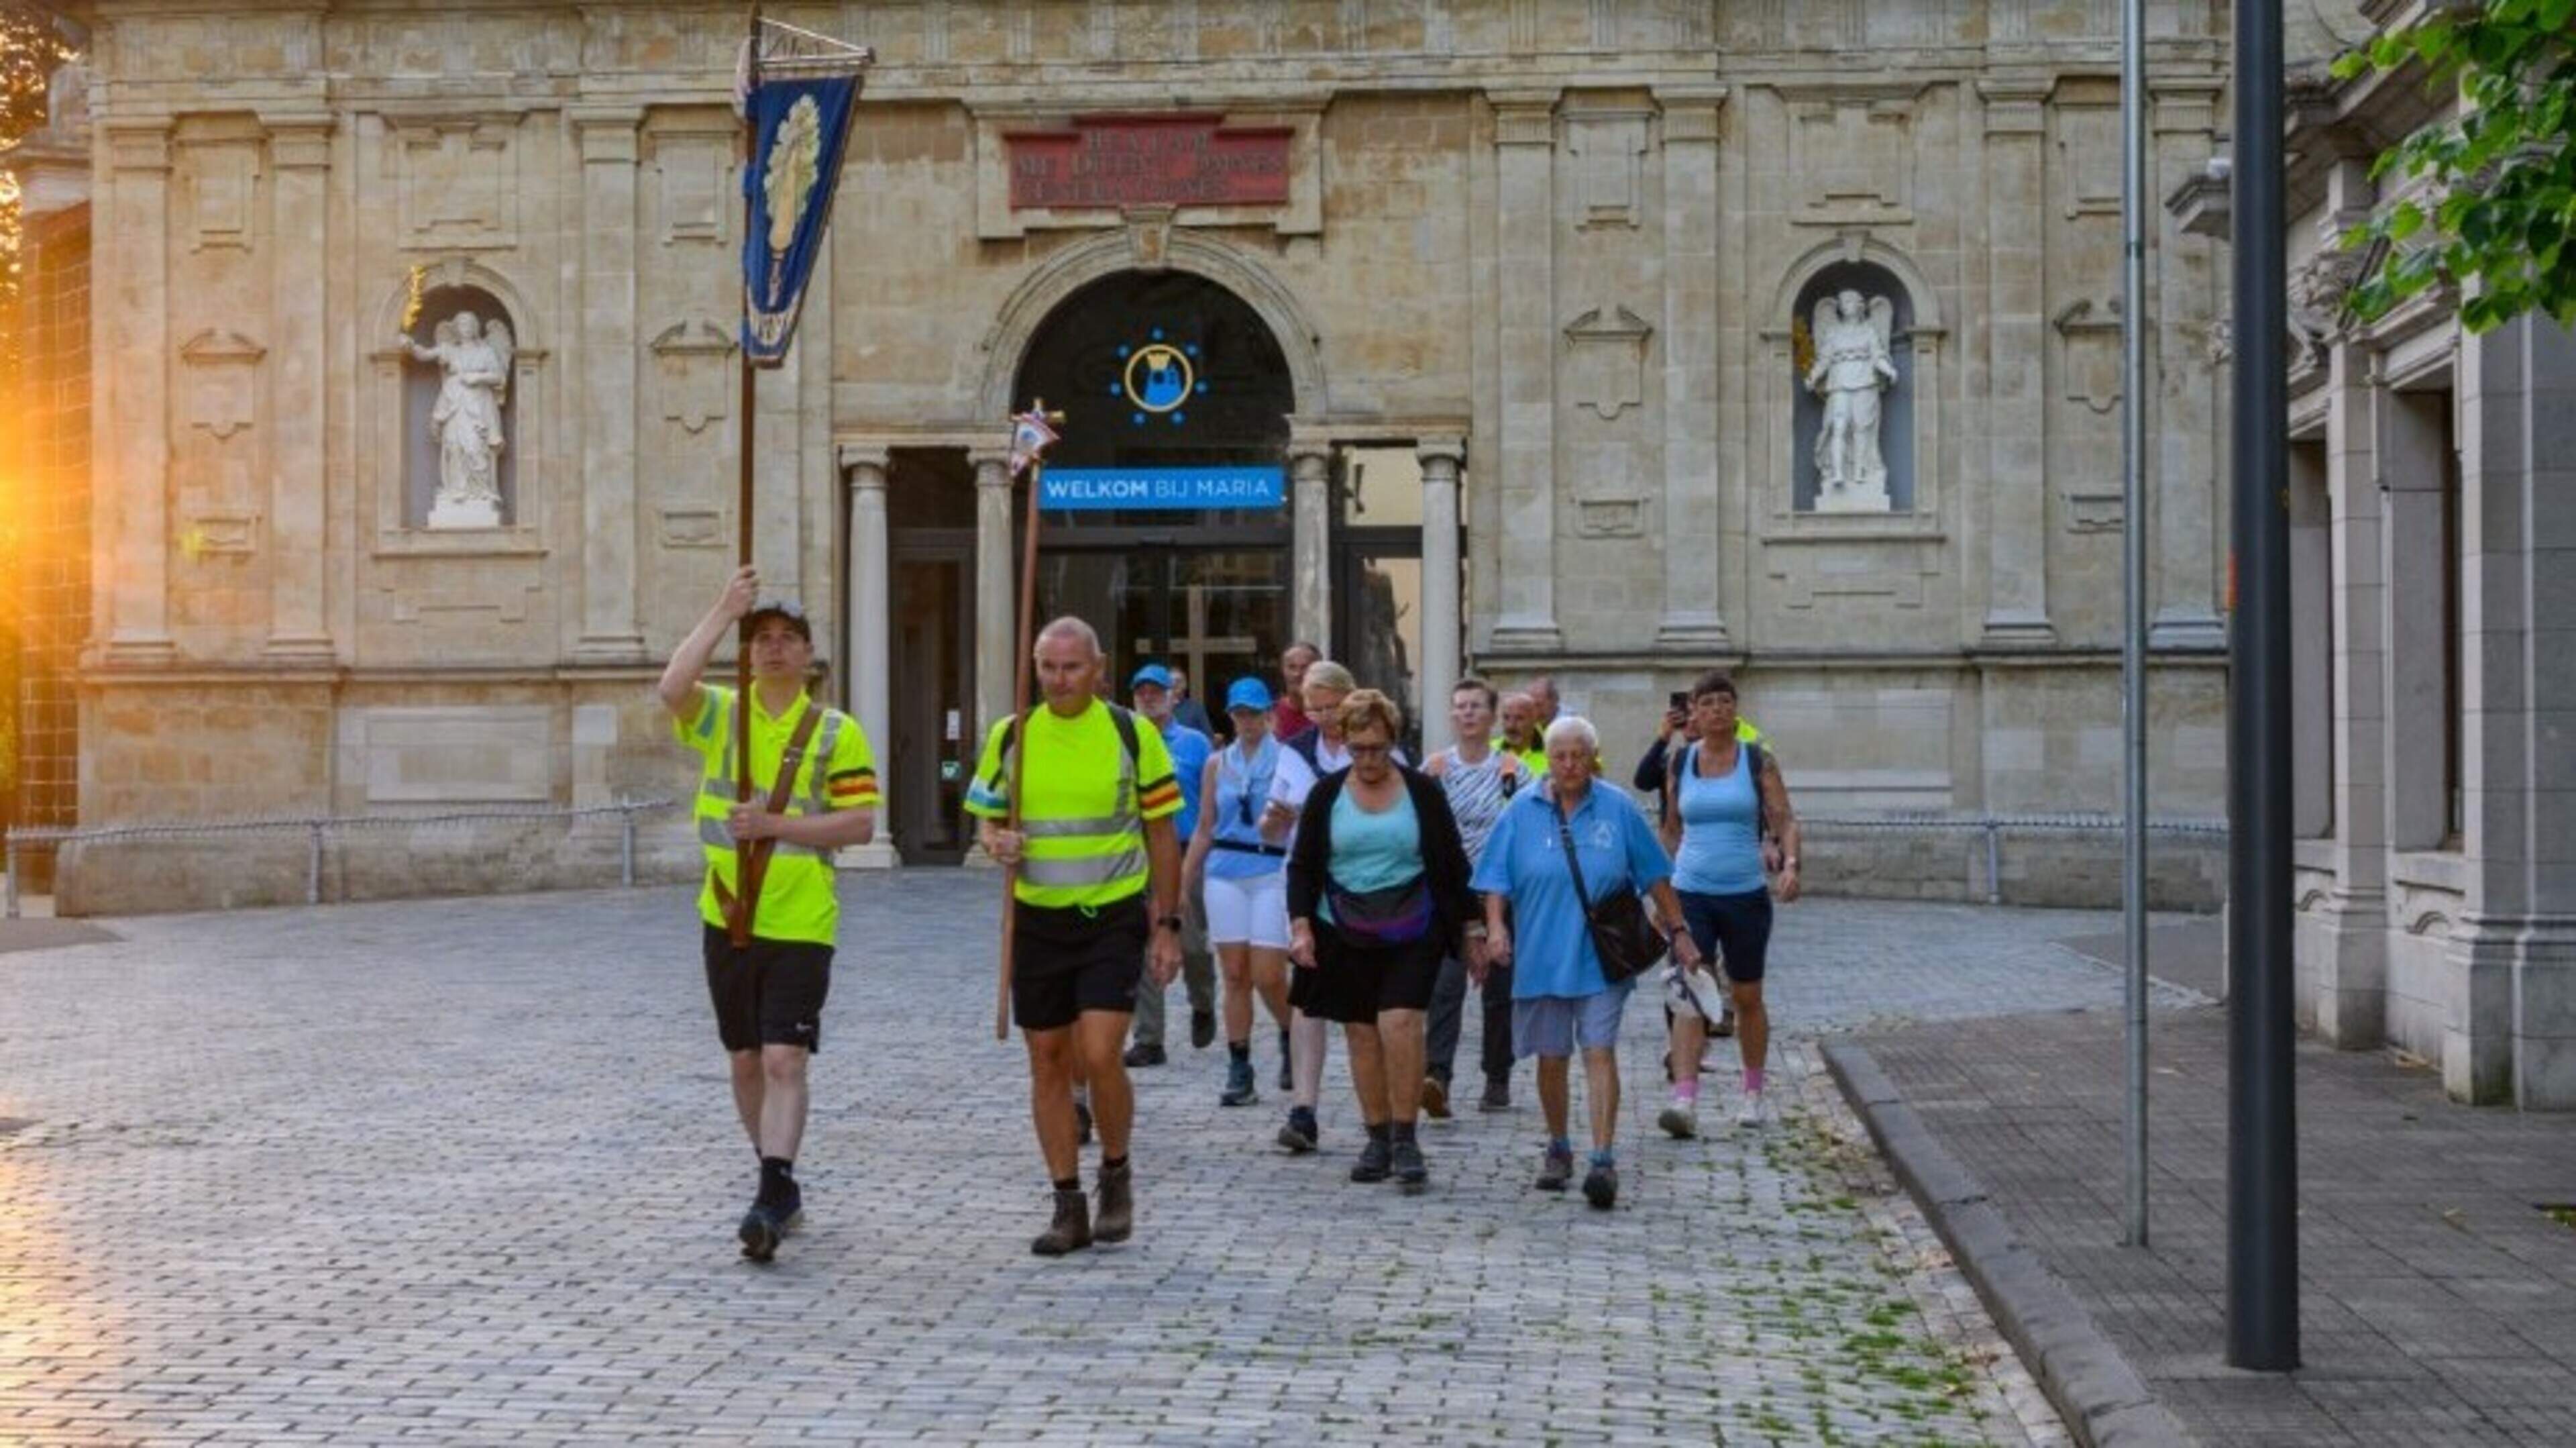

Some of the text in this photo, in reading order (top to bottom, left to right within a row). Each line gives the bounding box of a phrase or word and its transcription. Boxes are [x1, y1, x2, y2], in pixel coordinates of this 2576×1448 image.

[1047, 479, 1270, 497] WELKOM BIJ MARIA
